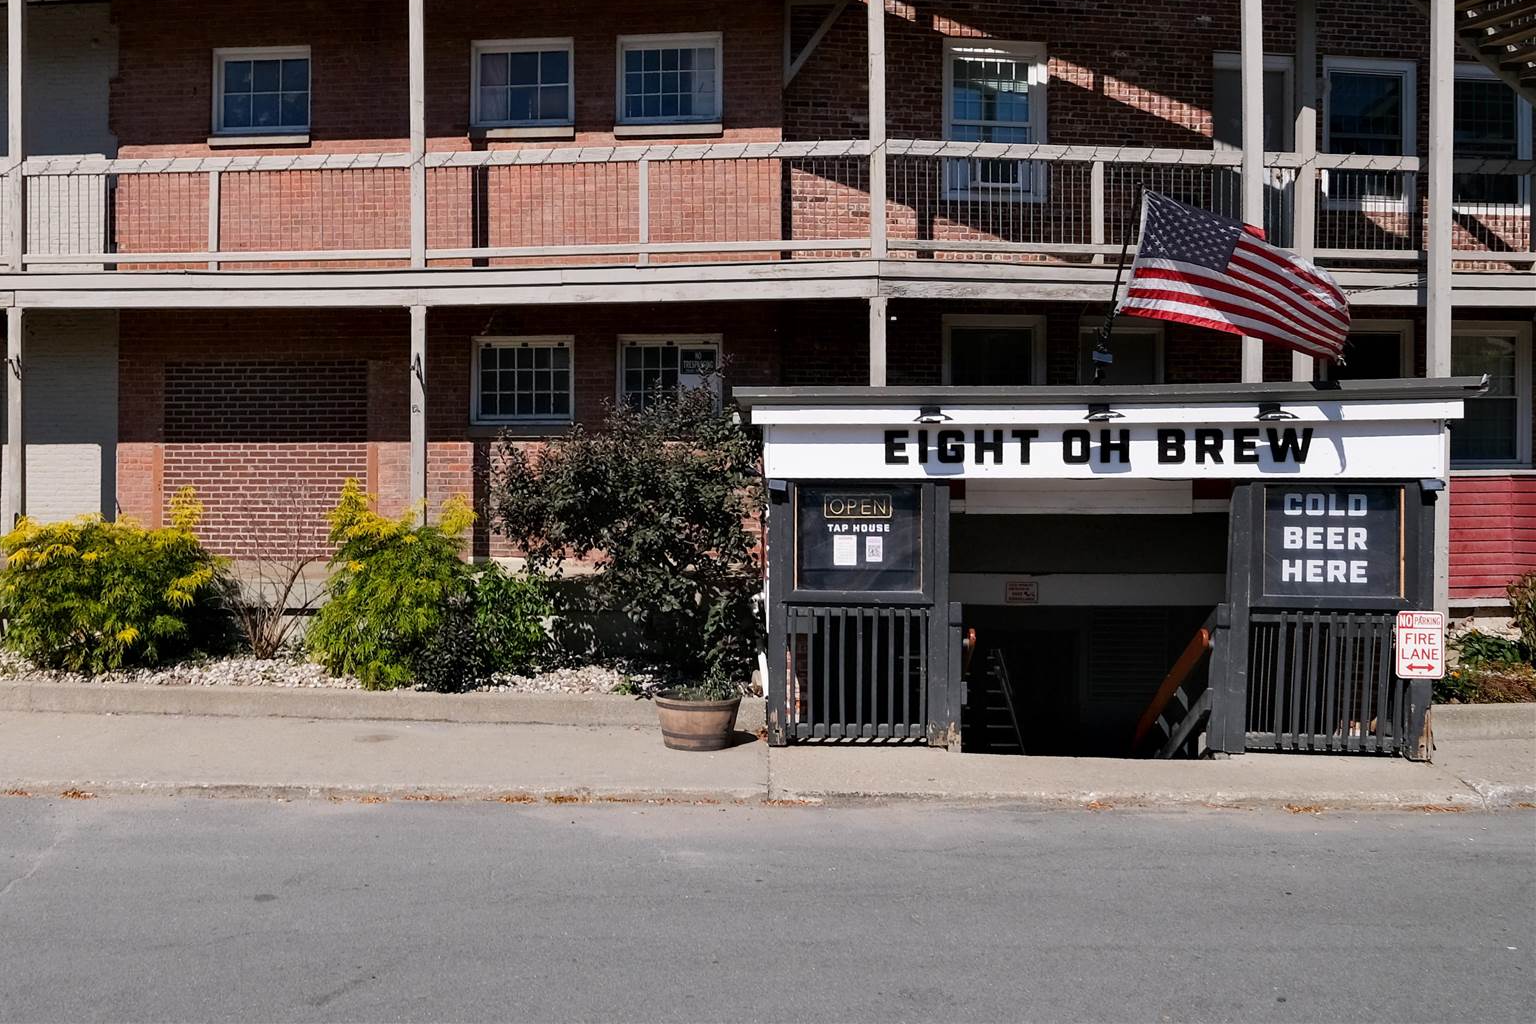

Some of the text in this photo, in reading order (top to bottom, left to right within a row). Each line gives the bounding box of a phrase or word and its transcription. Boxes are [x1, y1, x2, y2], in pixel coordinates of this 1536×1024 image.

[884, 428, 1314, 464] EIGHT OH BREW
[829, 498, 886, 515] OPEN
[1283, 493, 1368, 516] COLD
[827, 524, 890, 532] TAP HOUSE
[1283, 526, 1368, 550] BEER
[1282, 559, 1368, 583] HERE
[1399, 614, 1440, 627] NO PARKING
[1405, 632, 1436, 645] FIRE
[1402, 647, 1440, 660] LANE
